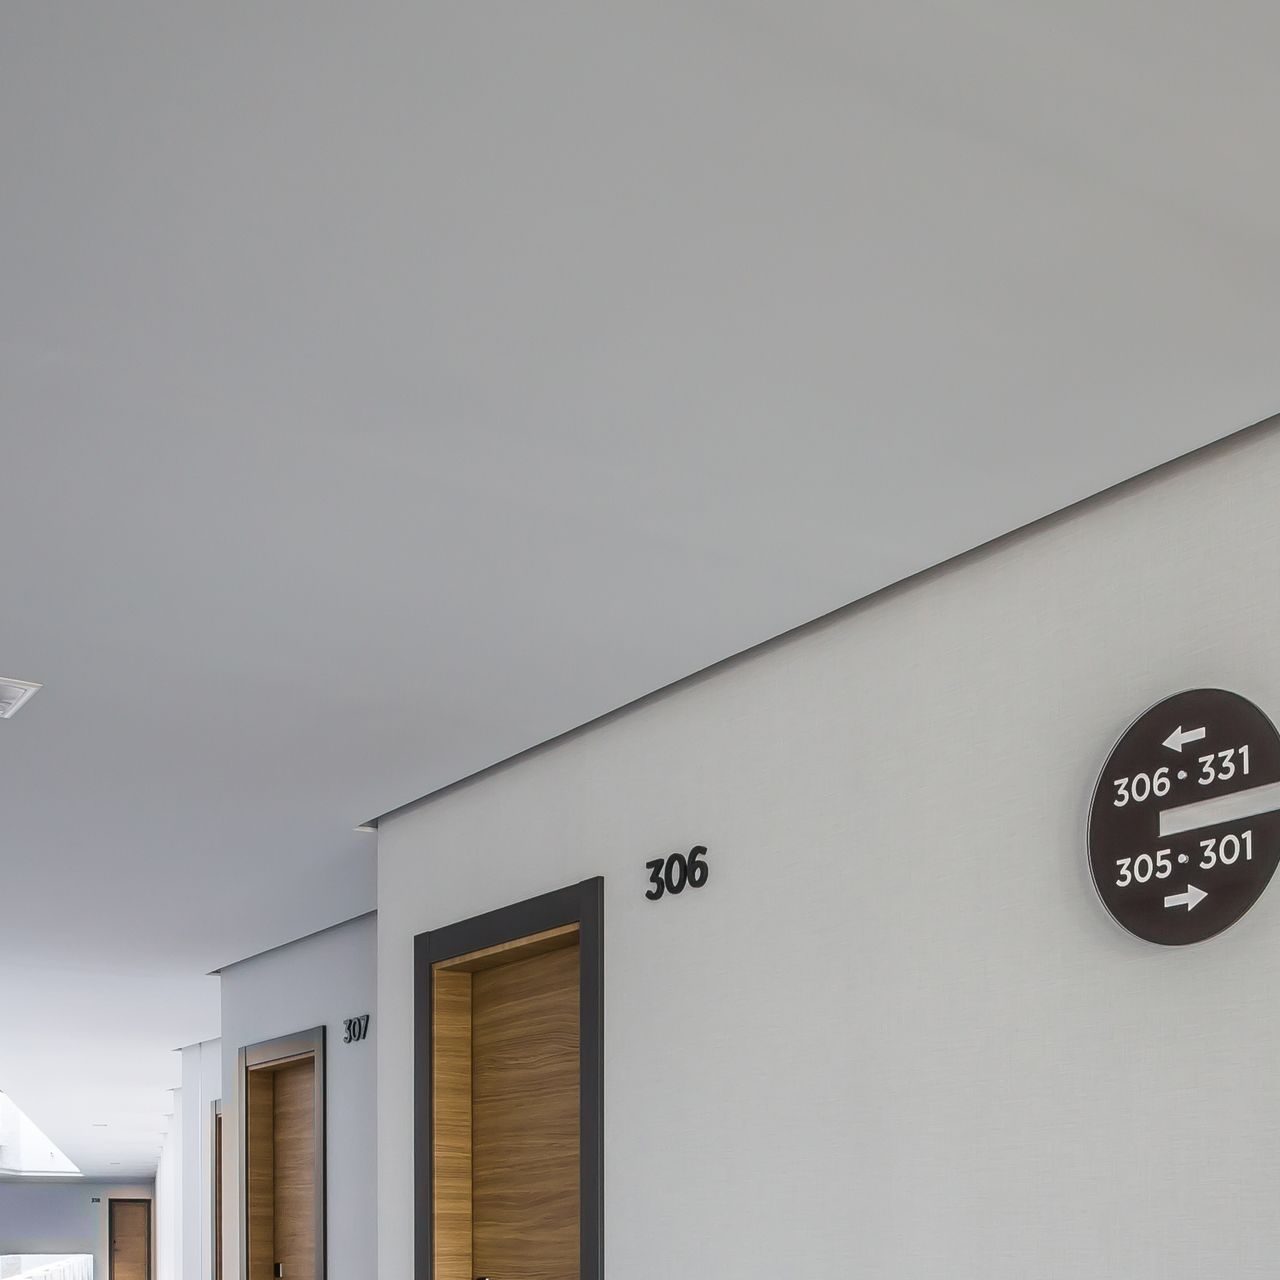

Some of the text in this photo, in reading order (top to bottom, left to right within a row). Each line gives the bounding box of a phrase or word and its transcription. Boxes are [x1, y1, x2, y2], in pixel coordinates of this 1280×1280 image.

[1113, 745, 1249, 807] 306 331
[645, 845, 709, 900] 306
[1116, 830, 1253, 887] 305 301
[342, 1014, 370, 1043] 307
